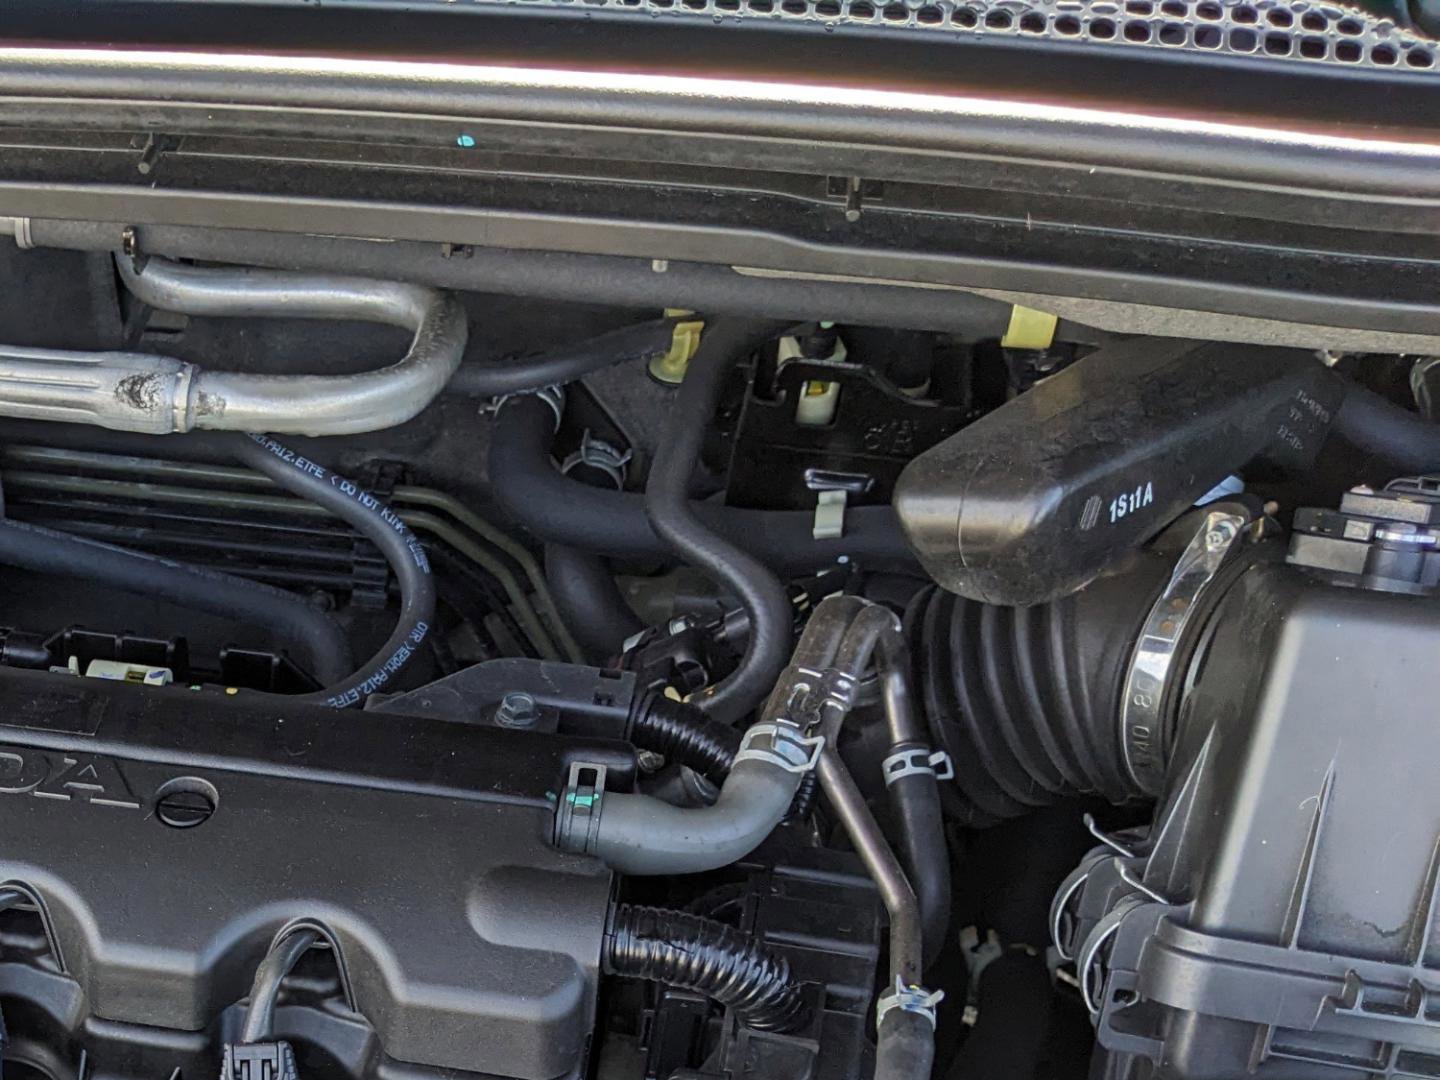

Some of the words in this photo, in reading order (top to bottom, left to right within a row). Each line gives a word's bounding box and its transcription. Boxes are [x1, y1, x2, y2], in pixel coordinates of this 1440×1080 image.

[339, 479, 358, 496] DO
[357, 491, 380, 511] NOT
[380, 506, 407, 534] KINK
